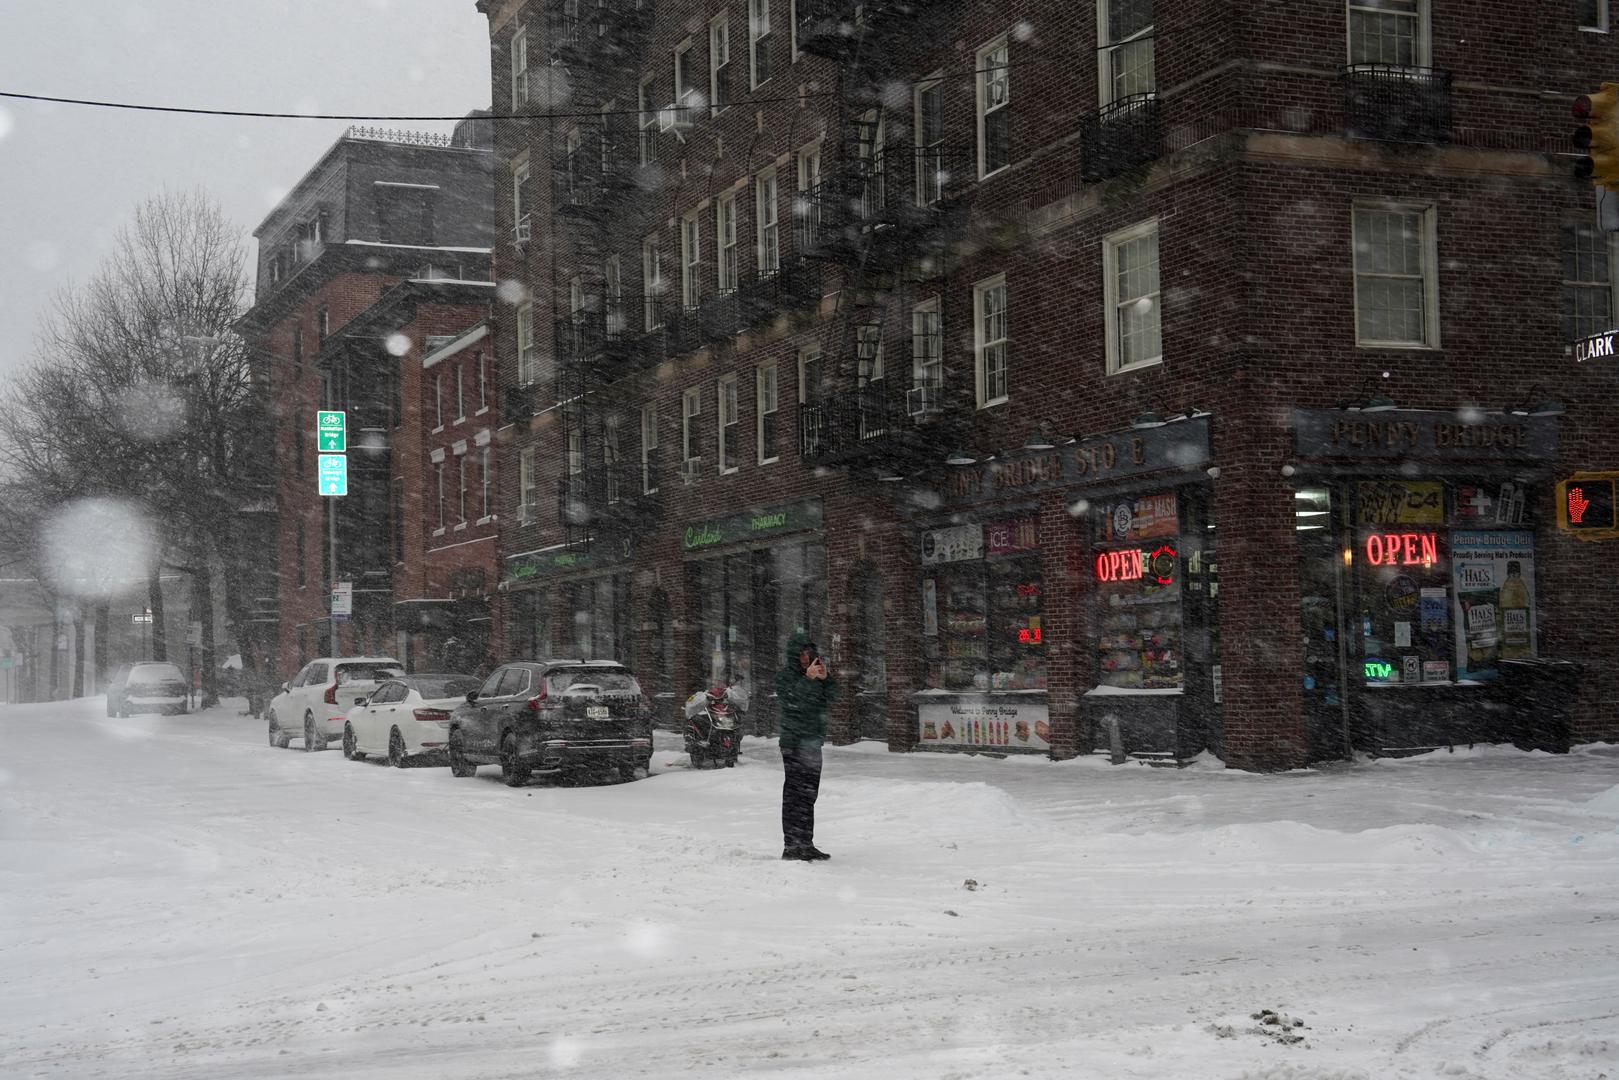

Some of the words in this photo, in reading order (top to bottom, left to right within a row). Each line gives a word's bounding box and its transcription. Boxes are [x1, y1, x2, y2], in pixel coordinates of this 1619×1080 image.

[1577, 336, 1614, 362] CLARK
[1331, 420, 1420, 447] PENNY
[1366, 533, 1437, 566] OPEN
[1453, 534, 1481, 546] Penny
[1098, 548, 1142, 582] OPEN
[1465, 568, 1490, 582] HAL'S
